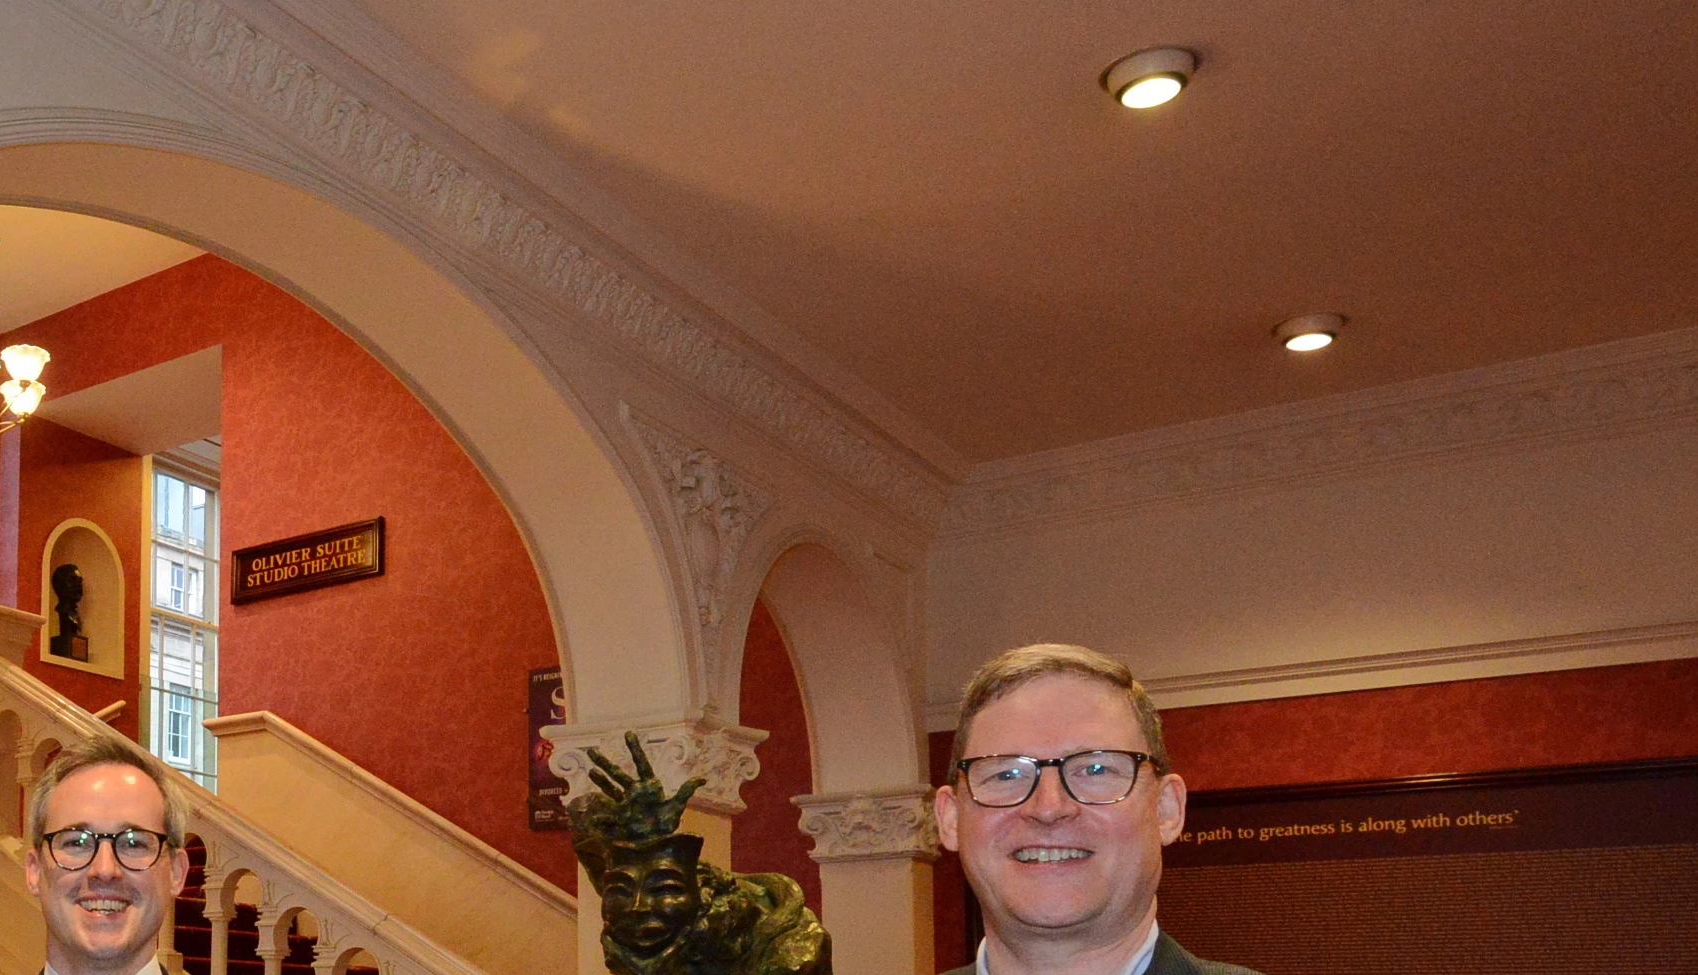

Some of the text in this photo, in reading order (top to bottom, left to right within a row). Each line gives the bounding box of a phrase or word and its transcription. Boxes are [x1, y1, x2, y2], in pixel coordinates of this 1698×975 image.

[247, 549, 366, 587] STUDIO THEATRE
[252, 536, 361, 571] OLIVIER SUITE
[1197, 826, 1232, 845] path
[1237, 827, 1255, 839] to
[1259, 822, 1336, 842] greatness
[1340, 820, 1353, 833] is
[1358, 816, 1407, 835] along
[1411, 812, 1451, 829] with
